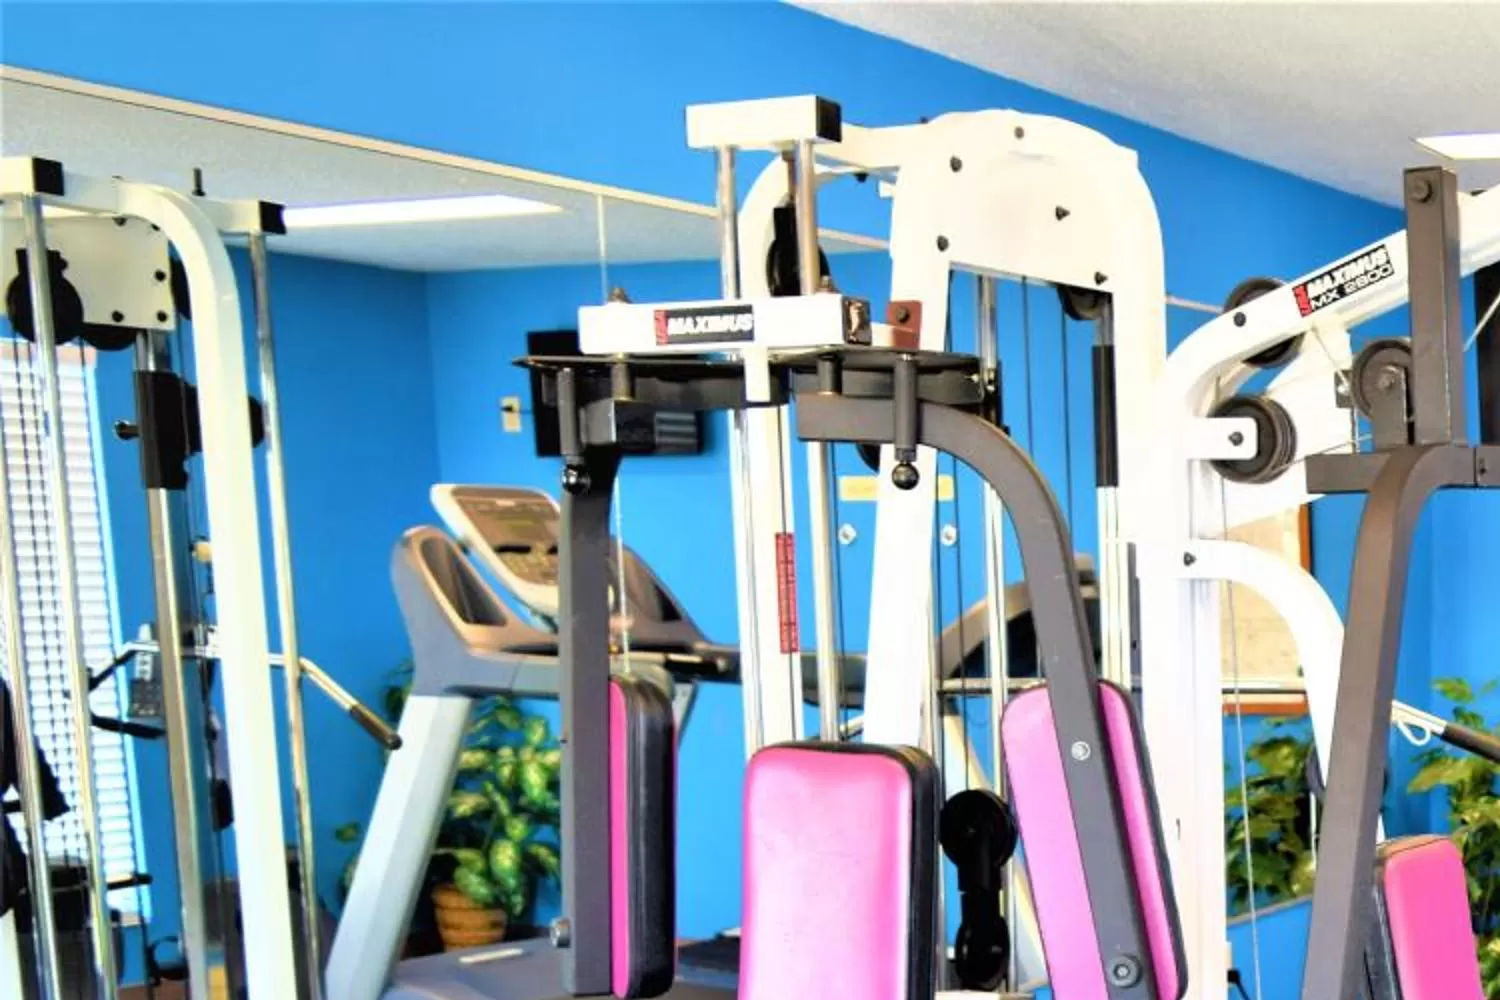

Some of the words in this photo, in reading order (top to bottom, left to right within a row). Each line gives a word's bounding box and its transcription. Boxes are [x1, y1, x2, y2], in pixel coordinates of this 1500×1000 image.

[1306, 248, 1388, 298] MAXIMUS
[1311, 289, 1341, 311] MX
[667, 313, 753, 336] MAXIMUS
